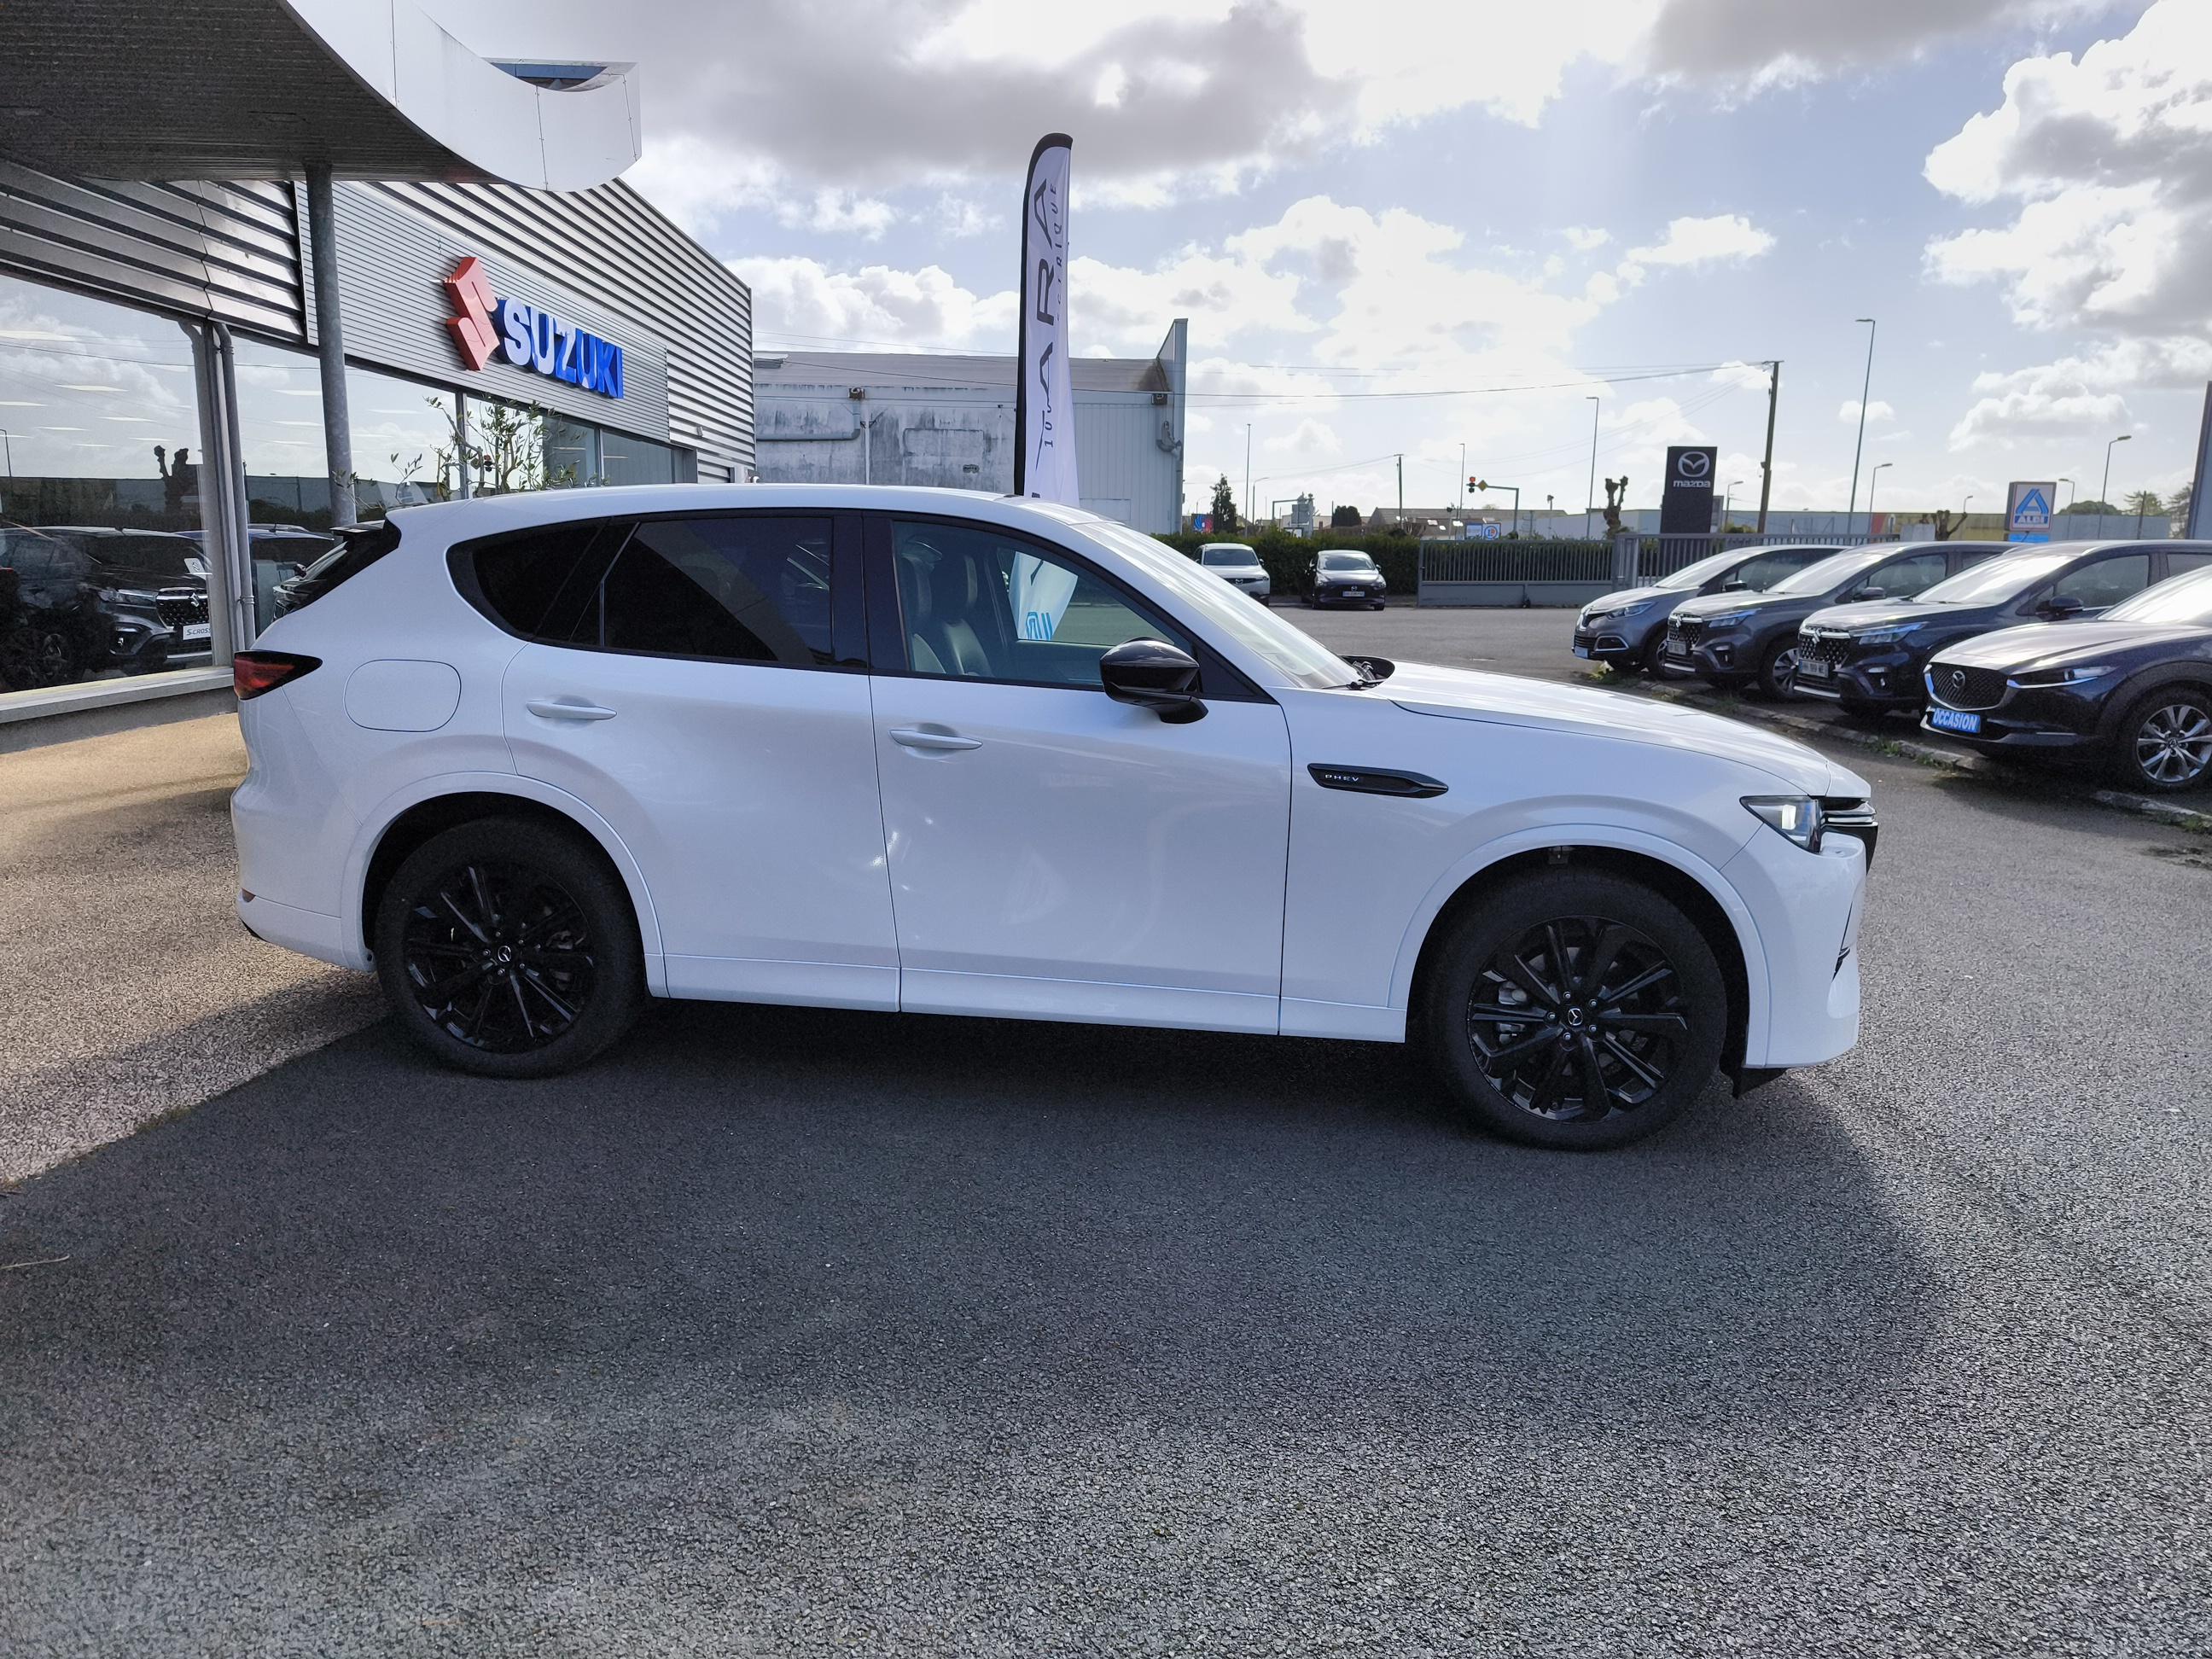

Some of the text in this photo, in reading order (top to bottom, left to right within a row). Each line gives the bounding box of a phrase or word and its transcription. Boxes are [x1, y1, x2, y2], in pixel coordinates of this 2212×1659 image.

[504, 297, 624, 399] SUZUKI
[2017, 515, 2046, 524] ALDI
[1932, 707, 1978, 731] OCCASION
[1324, 773, 1359, 783] PHEV
